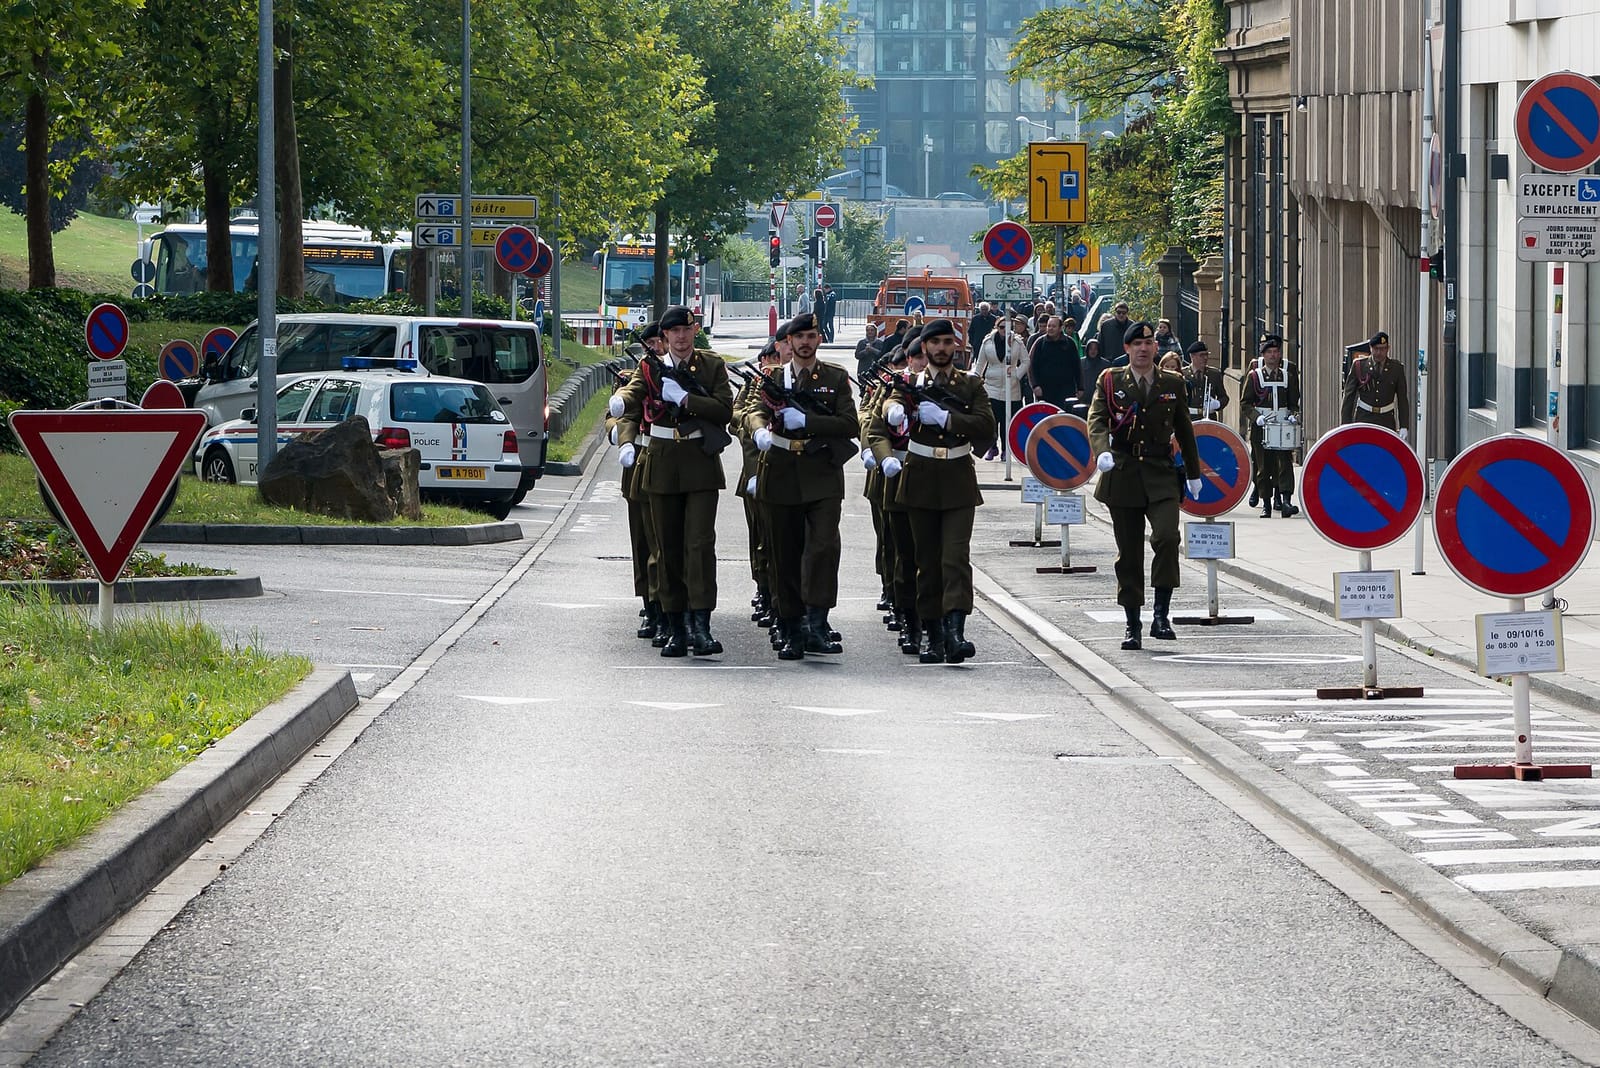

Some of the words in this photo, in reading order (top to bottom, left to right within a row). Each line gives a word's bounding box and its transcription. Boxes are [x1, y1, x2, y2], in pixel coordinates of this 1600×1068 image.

[1523, 184, 1576, 197] EXCEPTE
[471, 203, 506, 214] éâtre
[1526, 205, 1530, 214] 1
[1533, 205, 1597, 215] EMPLACEMENT
[414, 438, 440, 446] POLICE
[456, 469, 461, 478] A
[462, 469, 482, 478] 7801
[1490, 632, 1499, 640] le
[1506, 629, 1544, 639] 09/10/16
